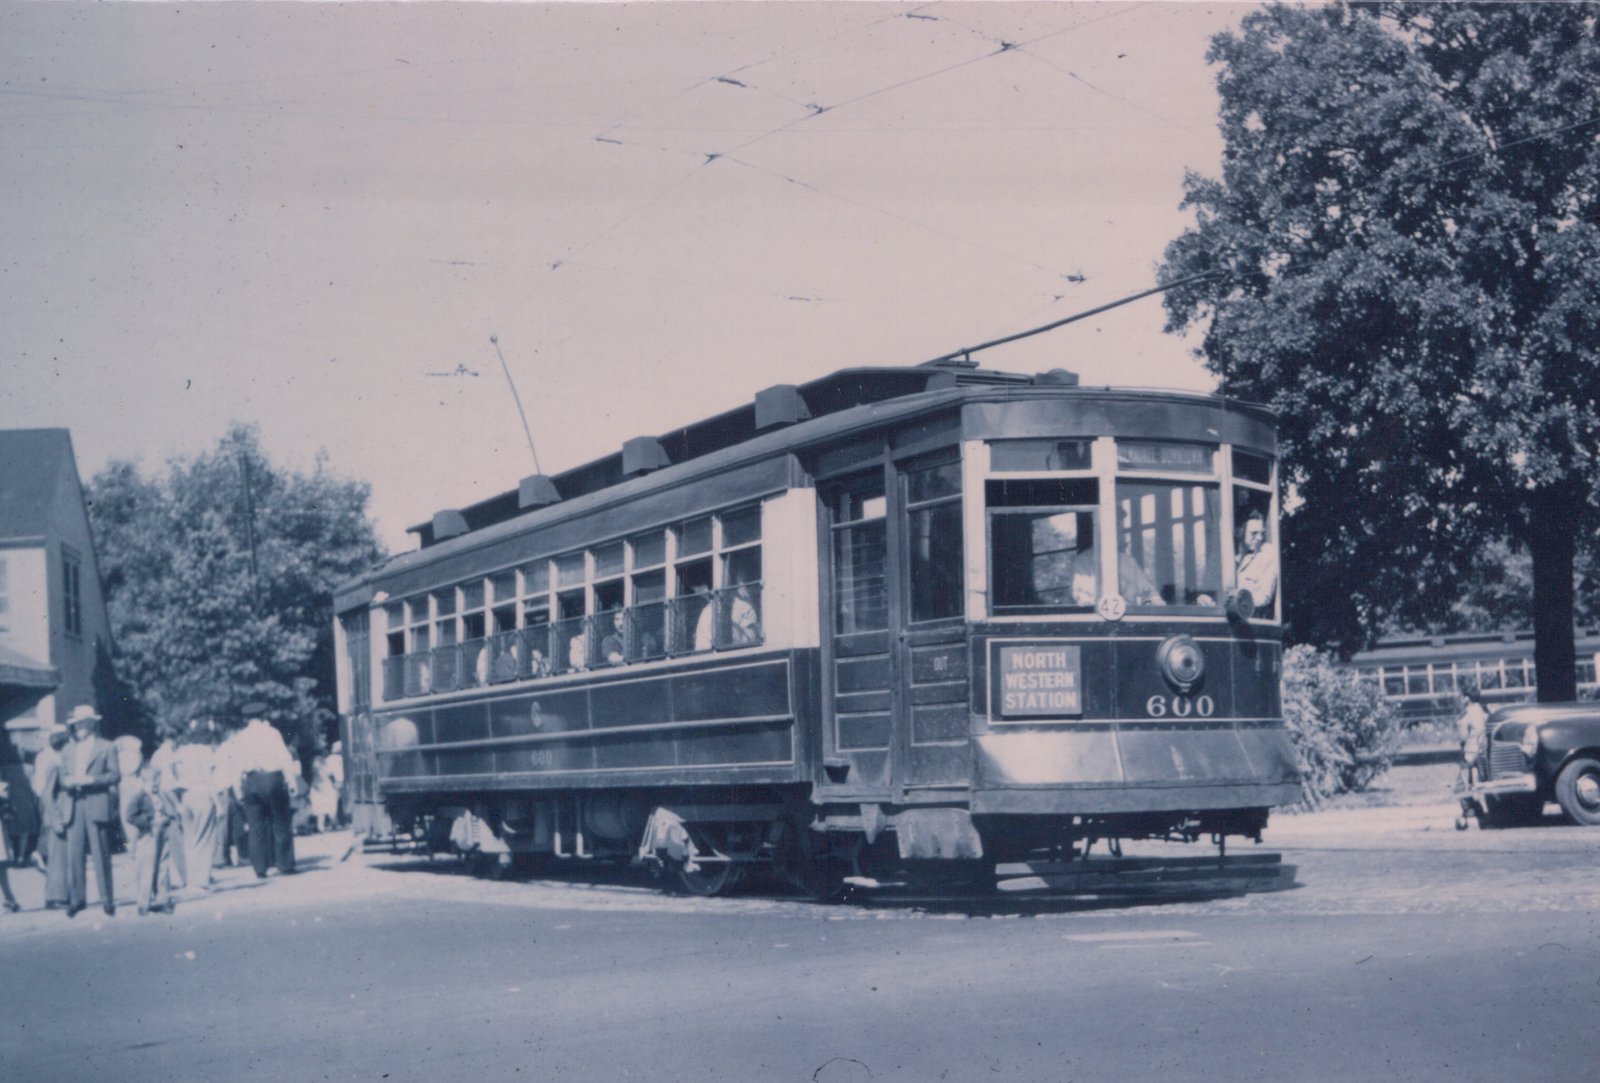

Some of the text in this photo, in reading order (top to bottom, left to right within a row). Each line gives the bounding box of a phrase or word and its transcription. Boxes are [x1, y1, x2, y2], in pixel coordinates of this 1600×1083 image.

[1101, 599, 1121, 615] 42
[1012, 652, 1066, 669] NORTH
[1005, 672, 1074, 689] WESTERN
[1006, 692, 1077, 709] STATION
[1147, 695, 1214, 717] 600
